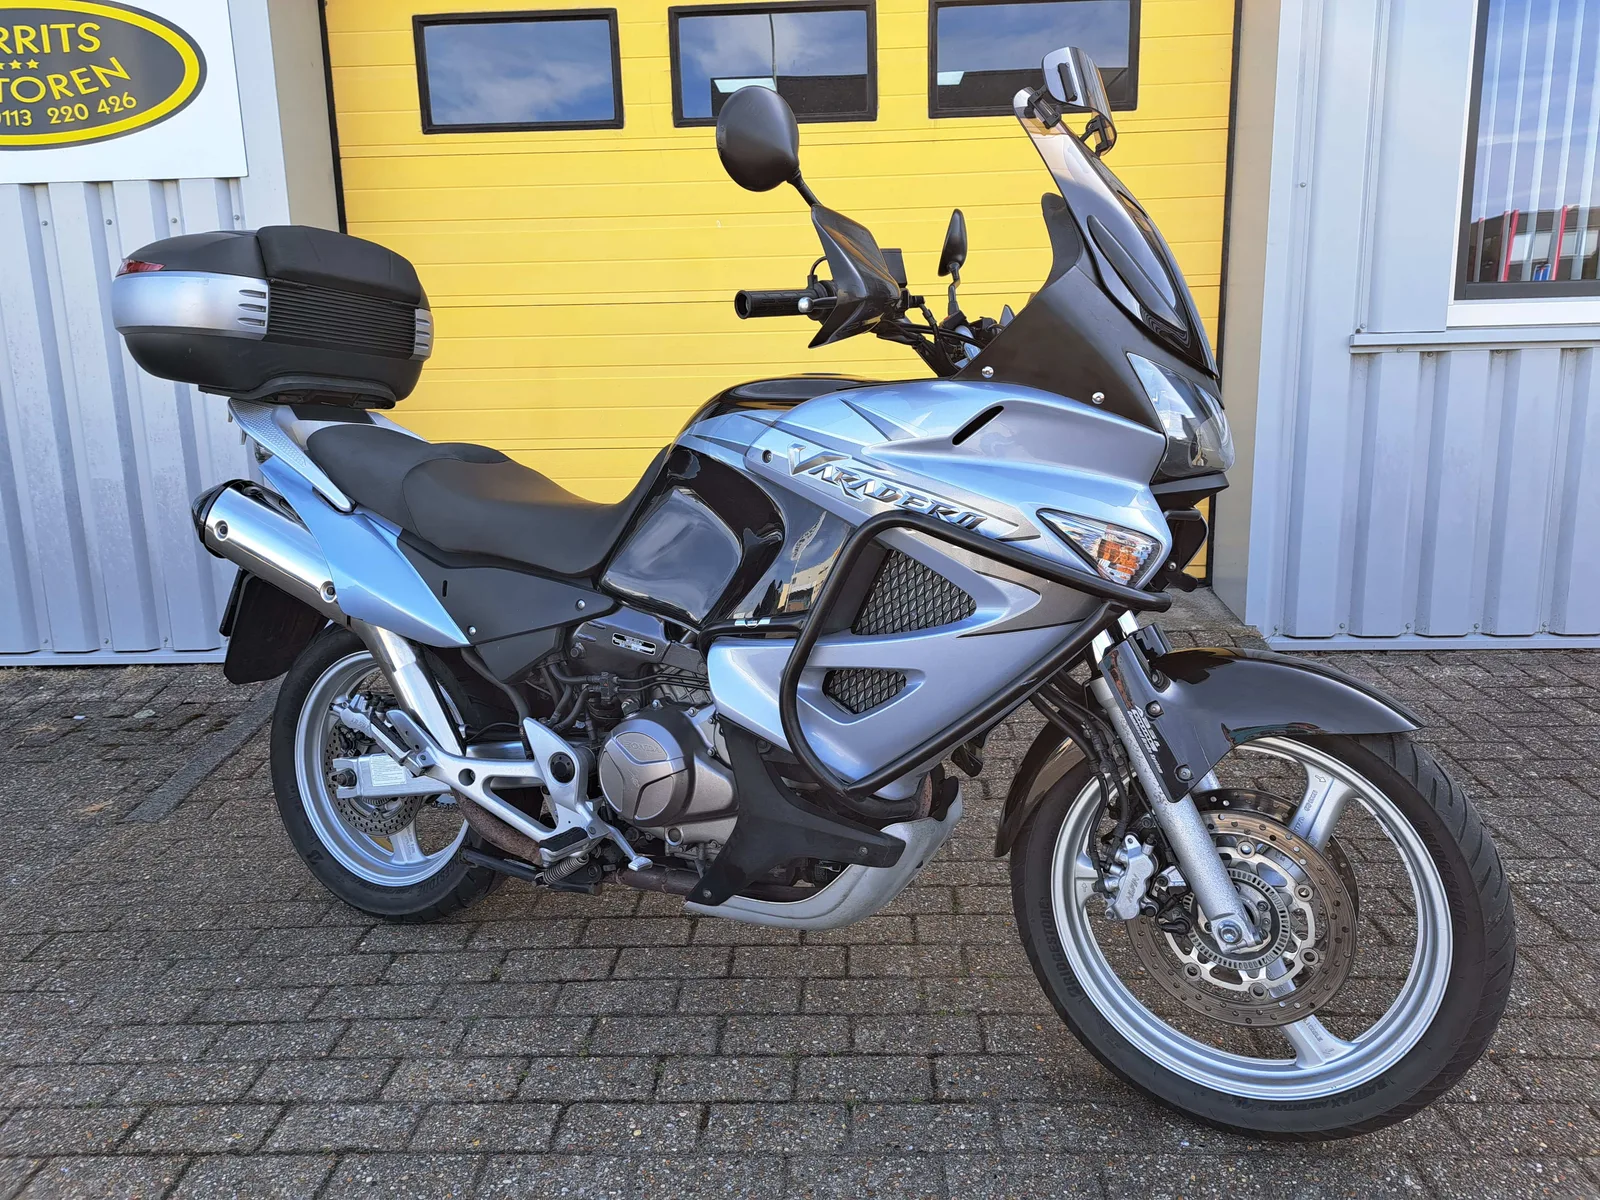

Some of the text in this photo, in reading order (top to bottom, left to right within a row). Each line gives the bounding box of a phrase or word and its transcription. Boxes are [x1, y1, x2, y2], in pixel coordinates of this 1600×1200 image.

[0, 91, 137, 126] 113 220 426
[787, 442, 988, 531] VARADERO
[1036, 900, 1083, 999] BRIDGESTONE
